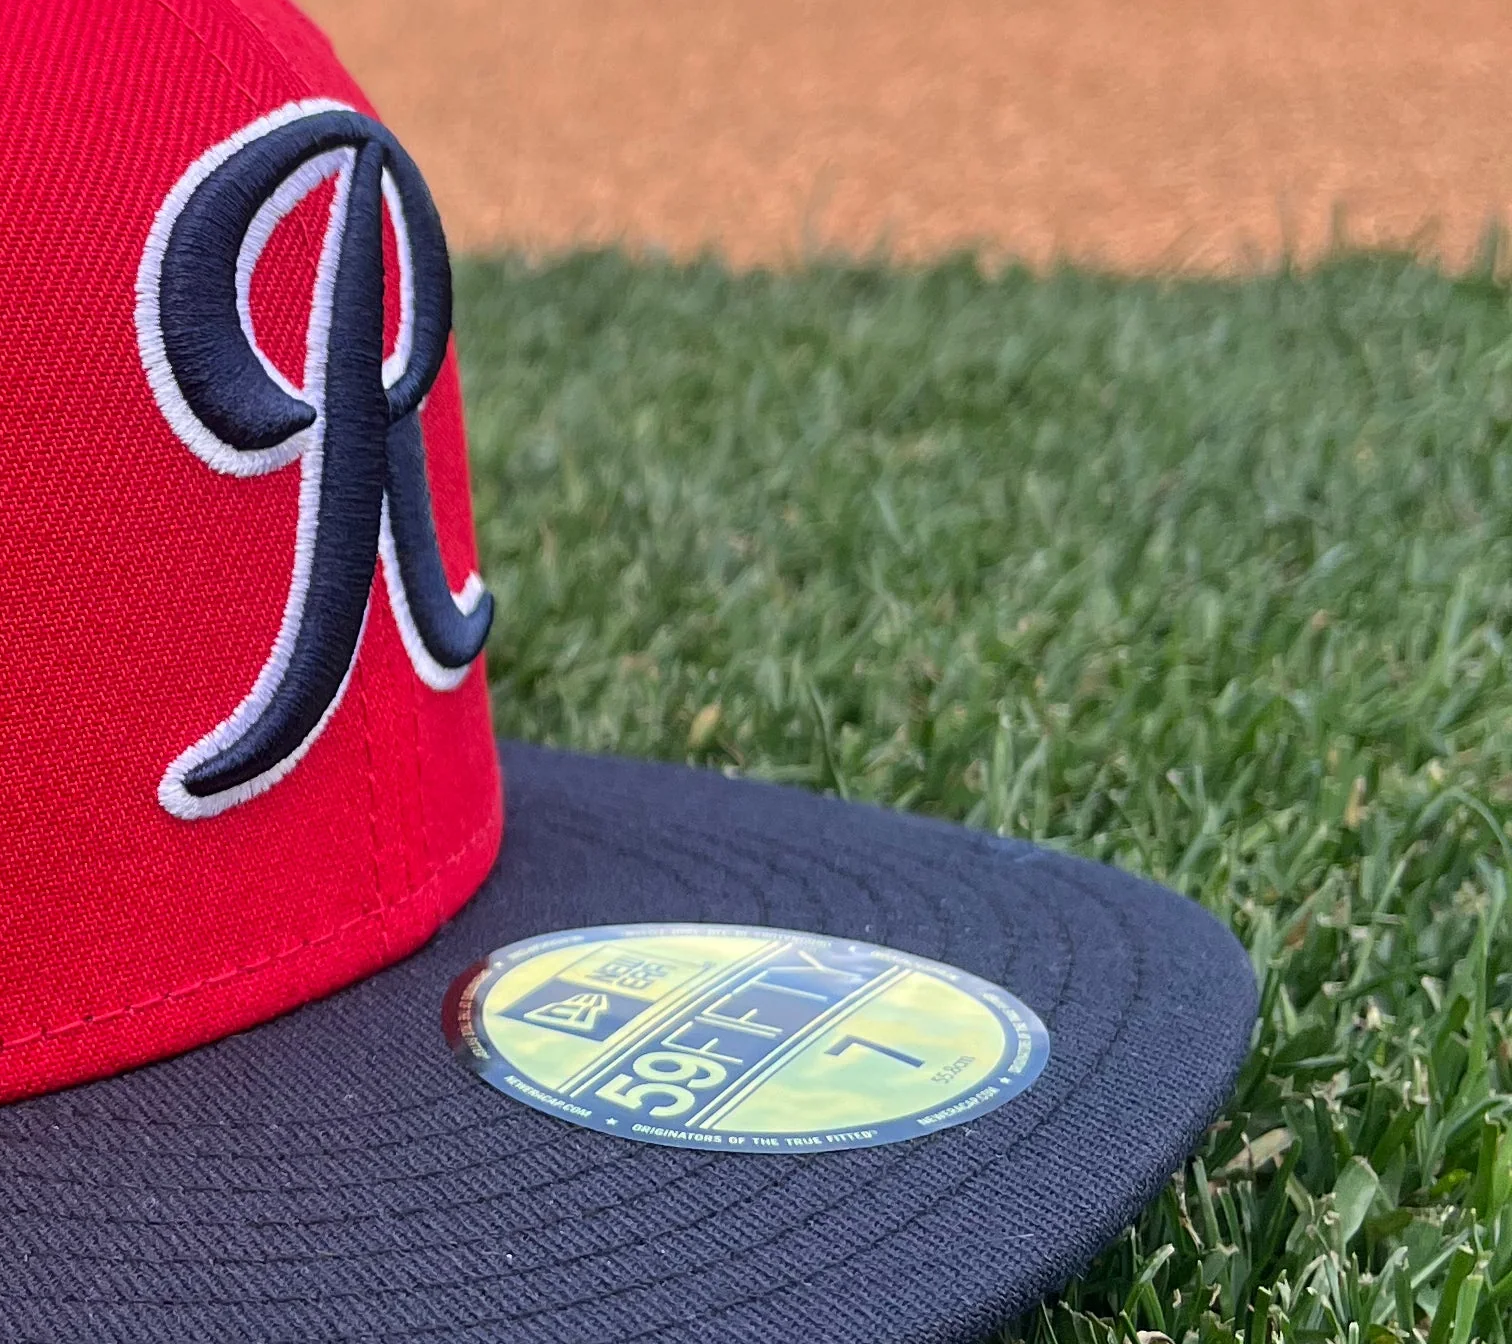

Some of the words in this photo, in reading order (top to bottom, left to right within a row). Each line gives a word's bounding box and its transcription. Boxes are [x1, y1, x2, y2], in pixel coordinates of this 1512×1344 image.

[134, 98, 494, 820] R
[595, 950, 865, 1118] 59FIFTY
[824, 1034, 926, 1068] 7
[631, 1123, 722, 1143] ORIGINATORS
[728, 1136, 745, 1145] OF
[752, 1137, 780, 1146] THE
[786, 1136, 822, 1146] TRUE
